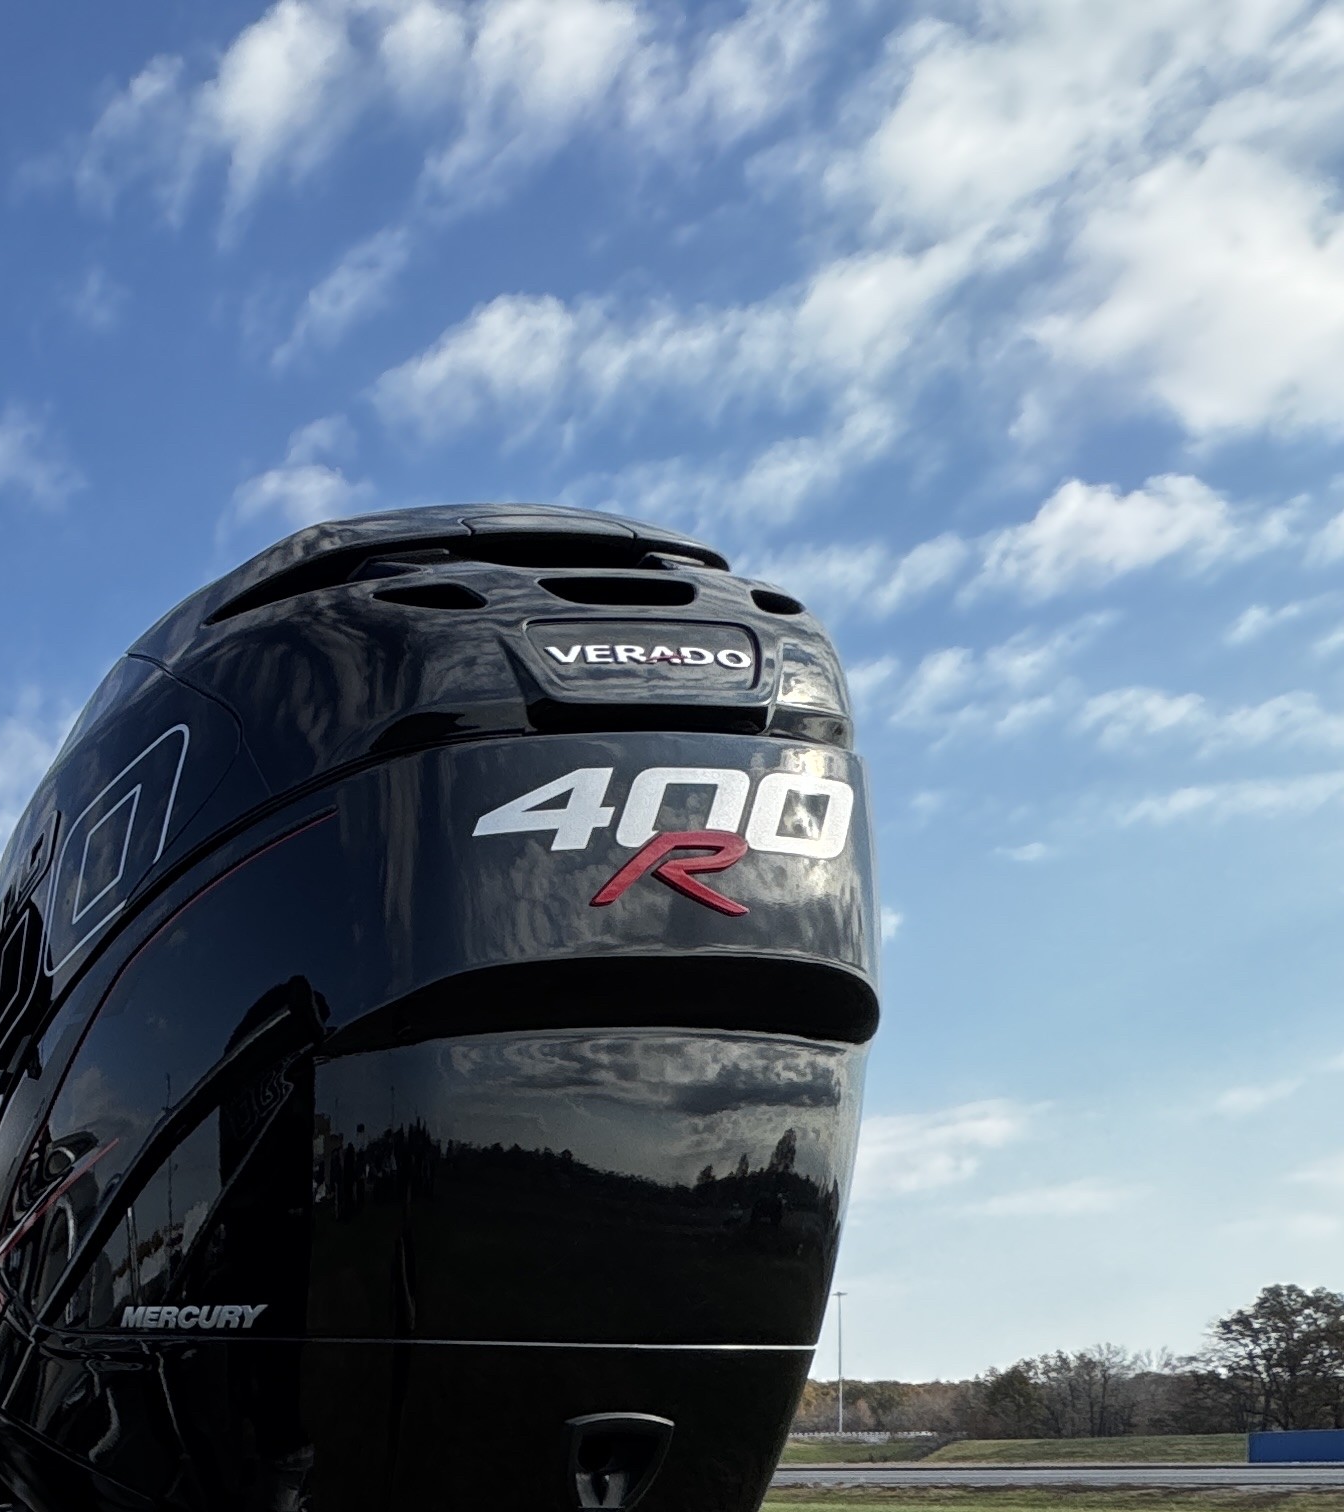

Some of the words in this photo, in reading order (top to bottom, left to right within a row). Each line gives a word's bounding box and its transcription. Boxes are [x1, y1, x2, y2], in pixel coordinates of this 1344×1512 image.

[545, 645, 752, 668] VERADO
[472, 767, 855, 859] 400
[589, 829, 751, 918] R
[120, 1303, 269, 1329] MERCURY
